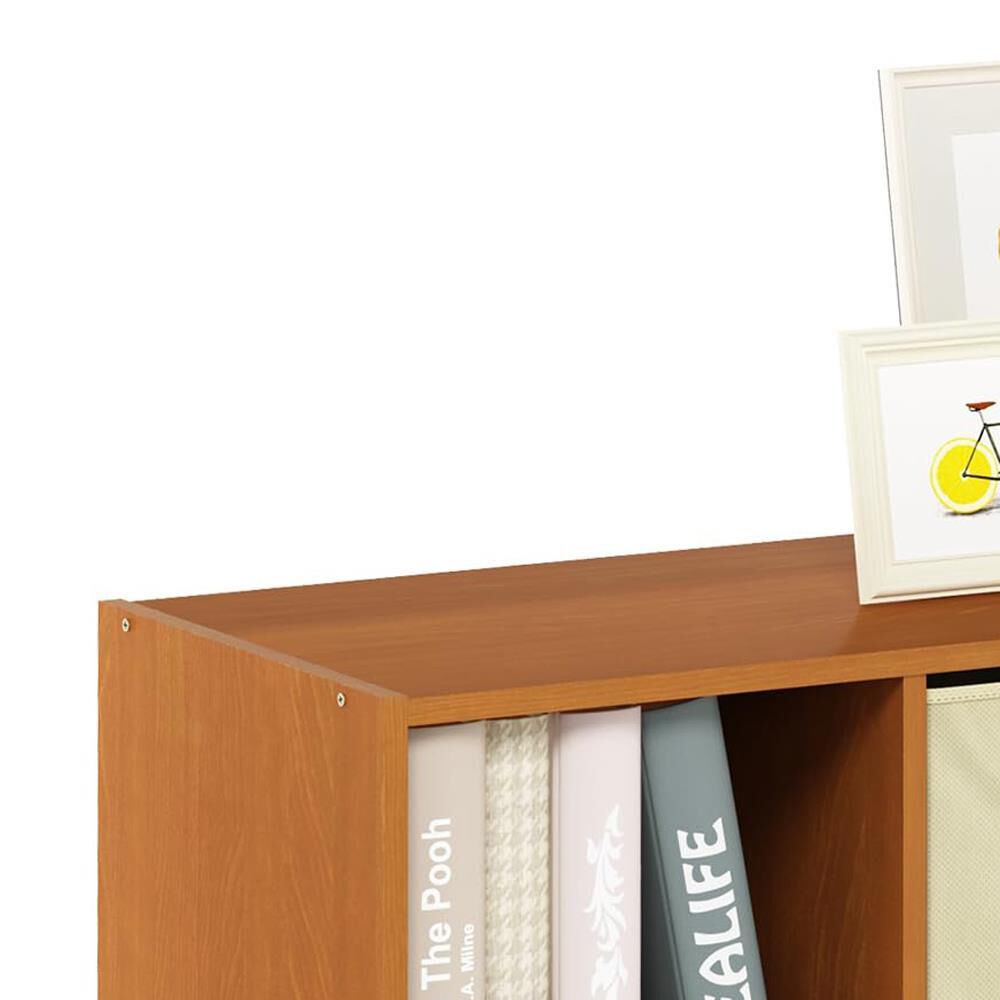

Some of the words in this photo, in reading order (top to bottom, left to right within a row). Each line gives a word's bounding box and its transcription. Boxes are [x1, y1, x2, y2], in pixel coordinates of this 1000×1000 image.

[420, 817, 452, 912] Pooh
[420, 921, 452, 991] The
[461, 923, 475, 972] Milne
